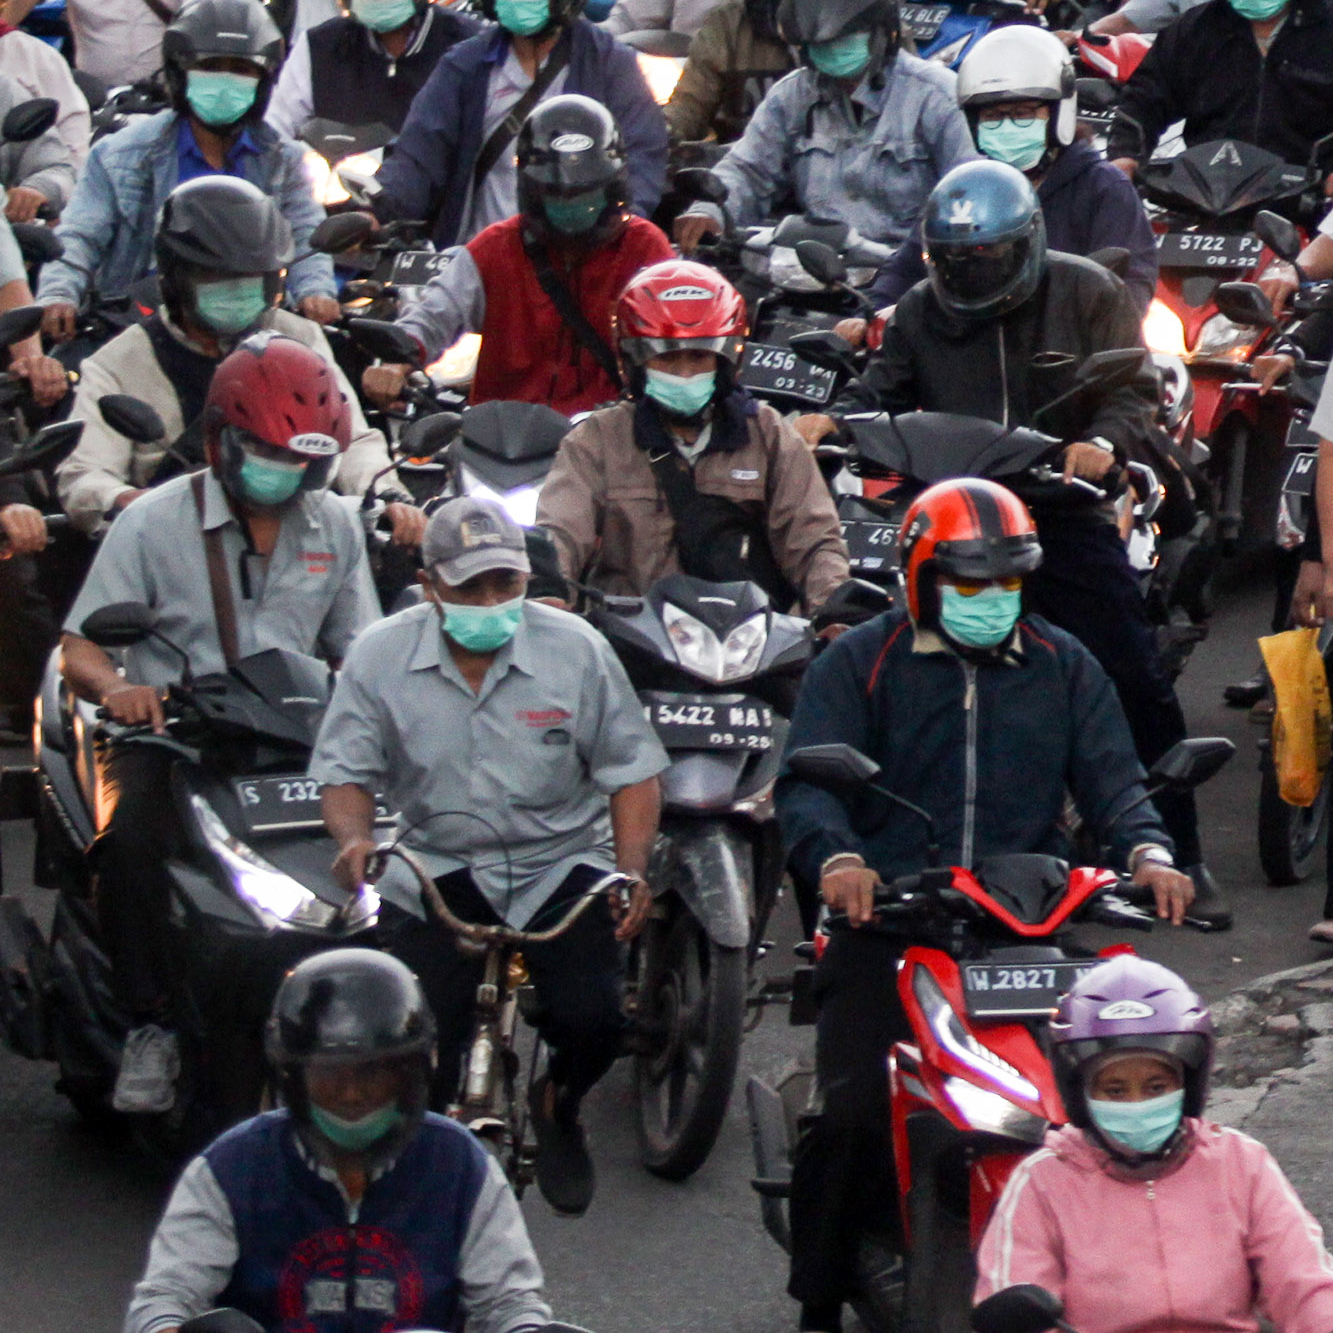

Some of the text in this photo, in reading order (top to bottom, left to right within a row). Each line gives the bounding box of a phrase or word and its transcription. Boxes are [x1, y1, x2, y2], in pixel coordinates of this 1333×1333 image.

[1181, 236, 1224, 252] 5722
[401, 254, 413, 268] W
[750, 349, 796, 372] 2456
[658, 705, 716, 726] 5422
[245, 787, 260, 805] S
[996, 970, 1057, 989] 2827
